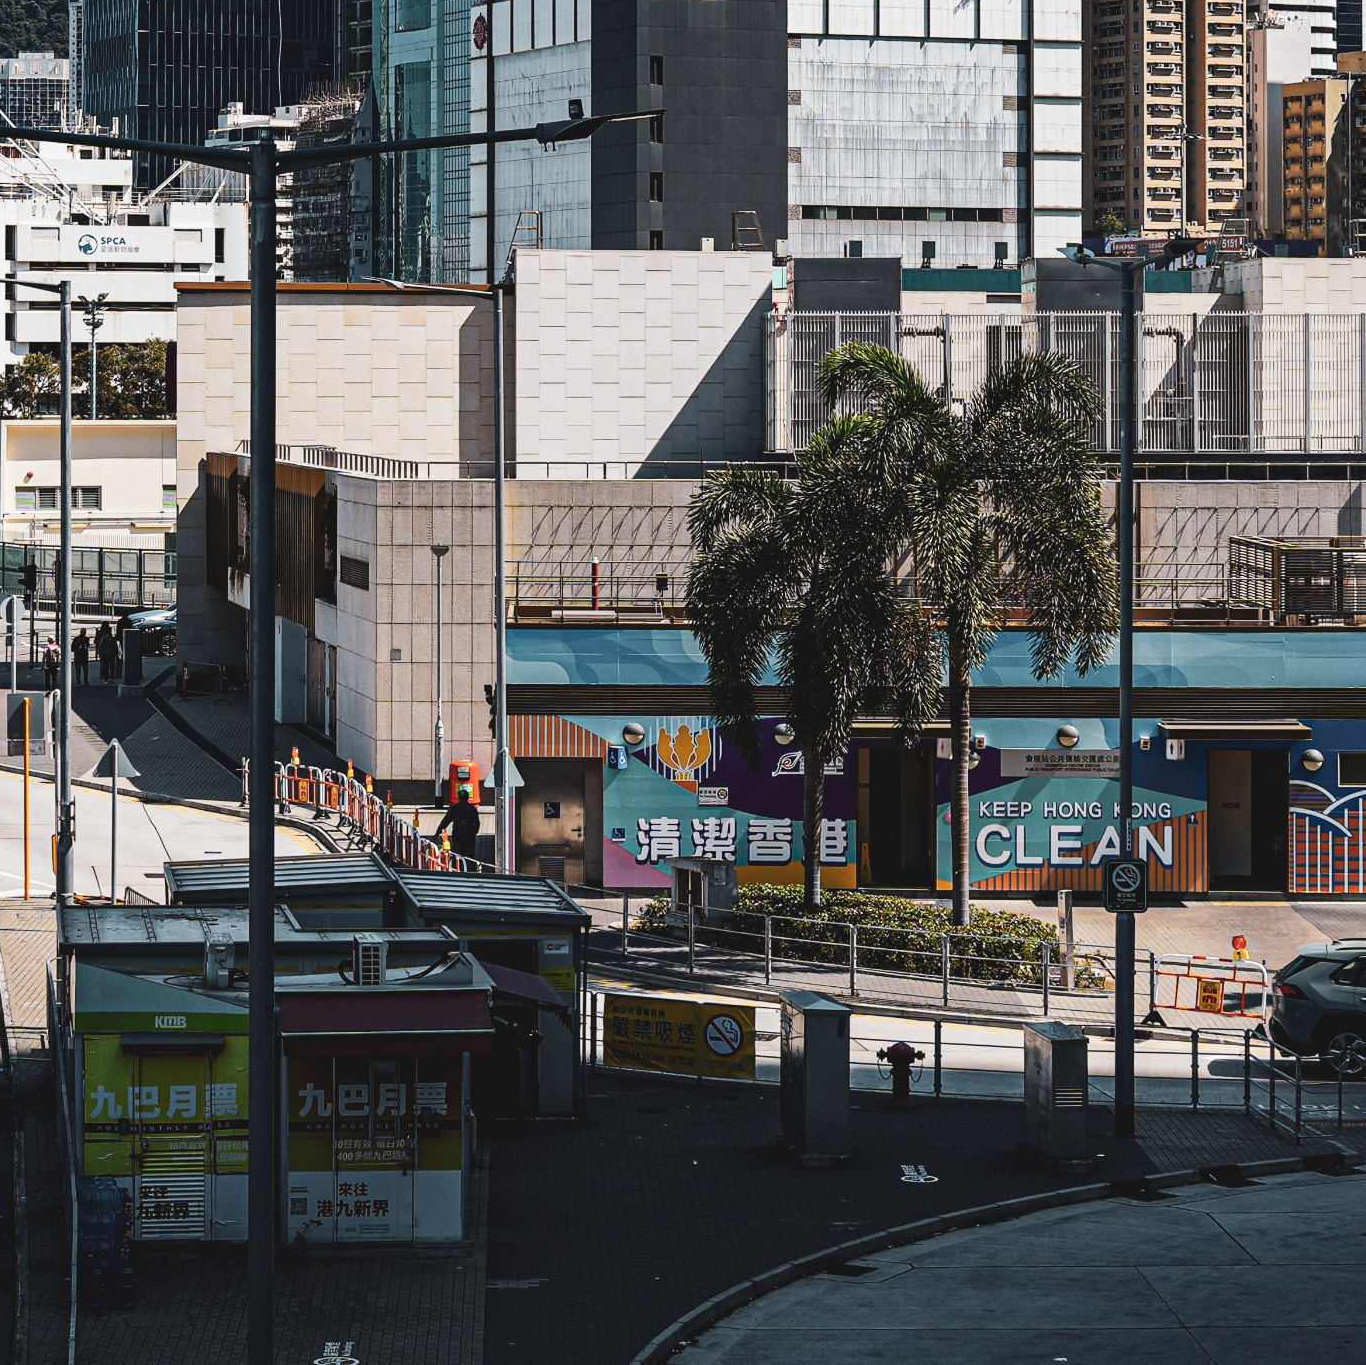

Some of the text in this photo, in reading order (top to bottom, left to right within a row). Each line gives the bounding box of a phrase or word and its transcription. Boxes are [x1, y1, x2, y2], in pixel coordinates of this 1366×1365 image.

[101, 237, 126, 245] SPCA
[979, 802, 1032, 818] KEEP
[1043, 802, 1102, 818] HONG
[975, 824, 1173, 866] CLEAN
[155, 1016, 187, 1028] KMB
[612, 1016, 696, 1045] 嚴禁吸煙
[90, 1083, 239, 1119] 九巴月票
[298, 1082, 448, 1118] 九巴月票
[338, 1182, 369, 1196] 來往
[317, 1199, 390, 1217] 港九新界
